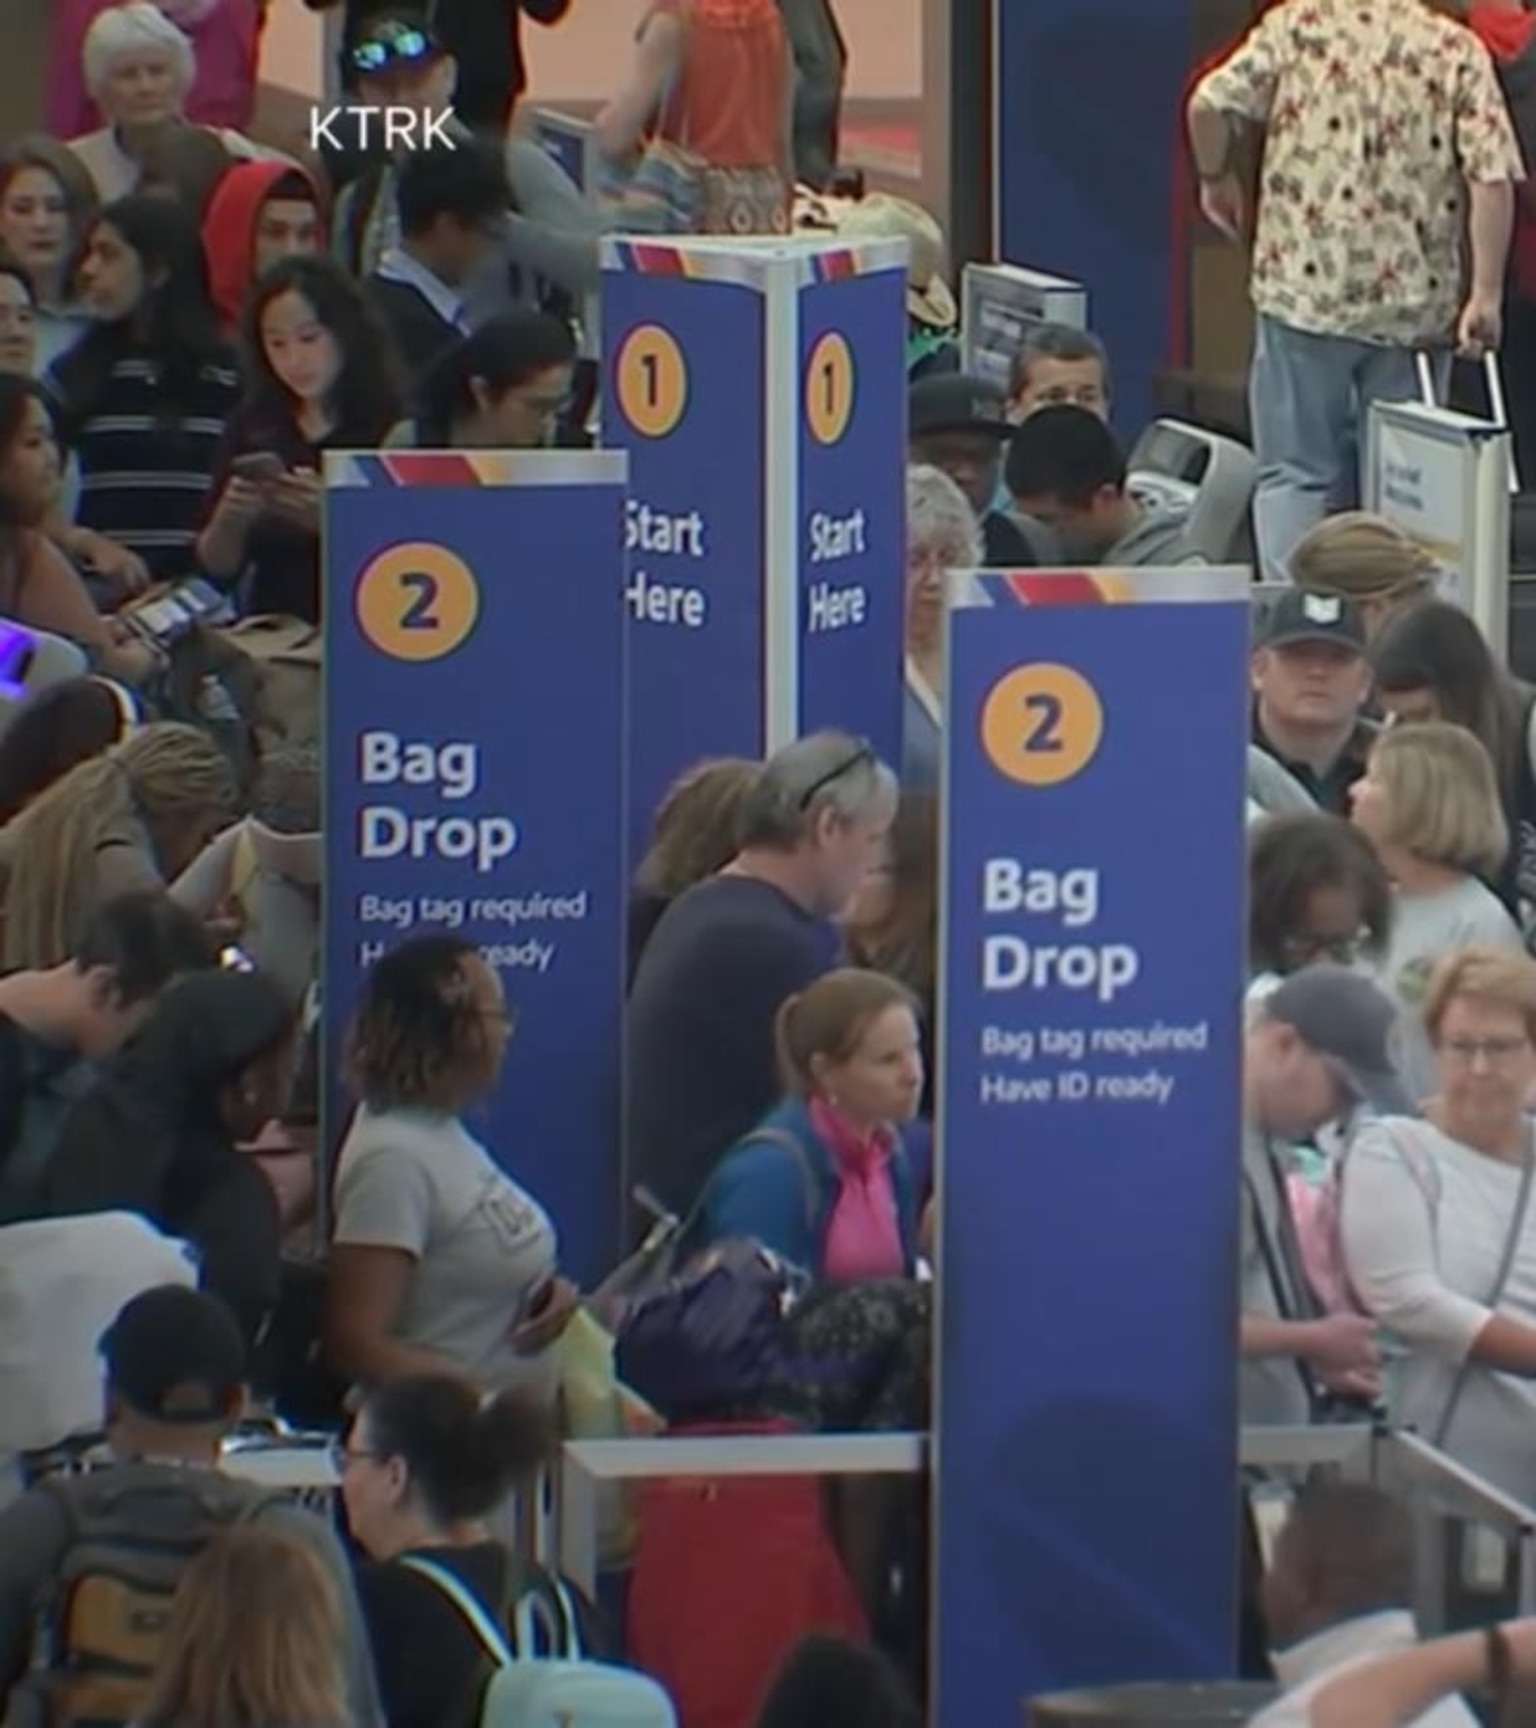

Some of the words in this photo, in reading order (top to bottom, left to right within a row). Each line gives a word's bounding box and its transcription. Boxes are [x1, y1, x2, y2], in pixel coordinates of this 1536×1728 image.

[641, 355, 657, 407] 1
[810, 507, 865, 563] Start
[399, 571, 440, 629] 2
[808, 581, 866, 633] Here
[1023, 693, 1063, 753] 2
[361, 730, 477, 799] Bag
[361, 804, 517, 873] Drop
[360, 894, 414, 929] Bag
[420, 898, 465, 929] tag
[470, 890, 588, 926] required
[984, 857, 1099, 927] Bag
[984, 934, 1139, 1003] Drop
[982, 1025, 1034, 1061] Bag
[1040, 1026, 1084, 1060] tag
[1091, 1019, 1209, 1057] required
[981, 1073, 1051, 1103] Have
[1058, 1070, 1090, 1100] ID
[1097, 1066, 1175, 1106] ready
